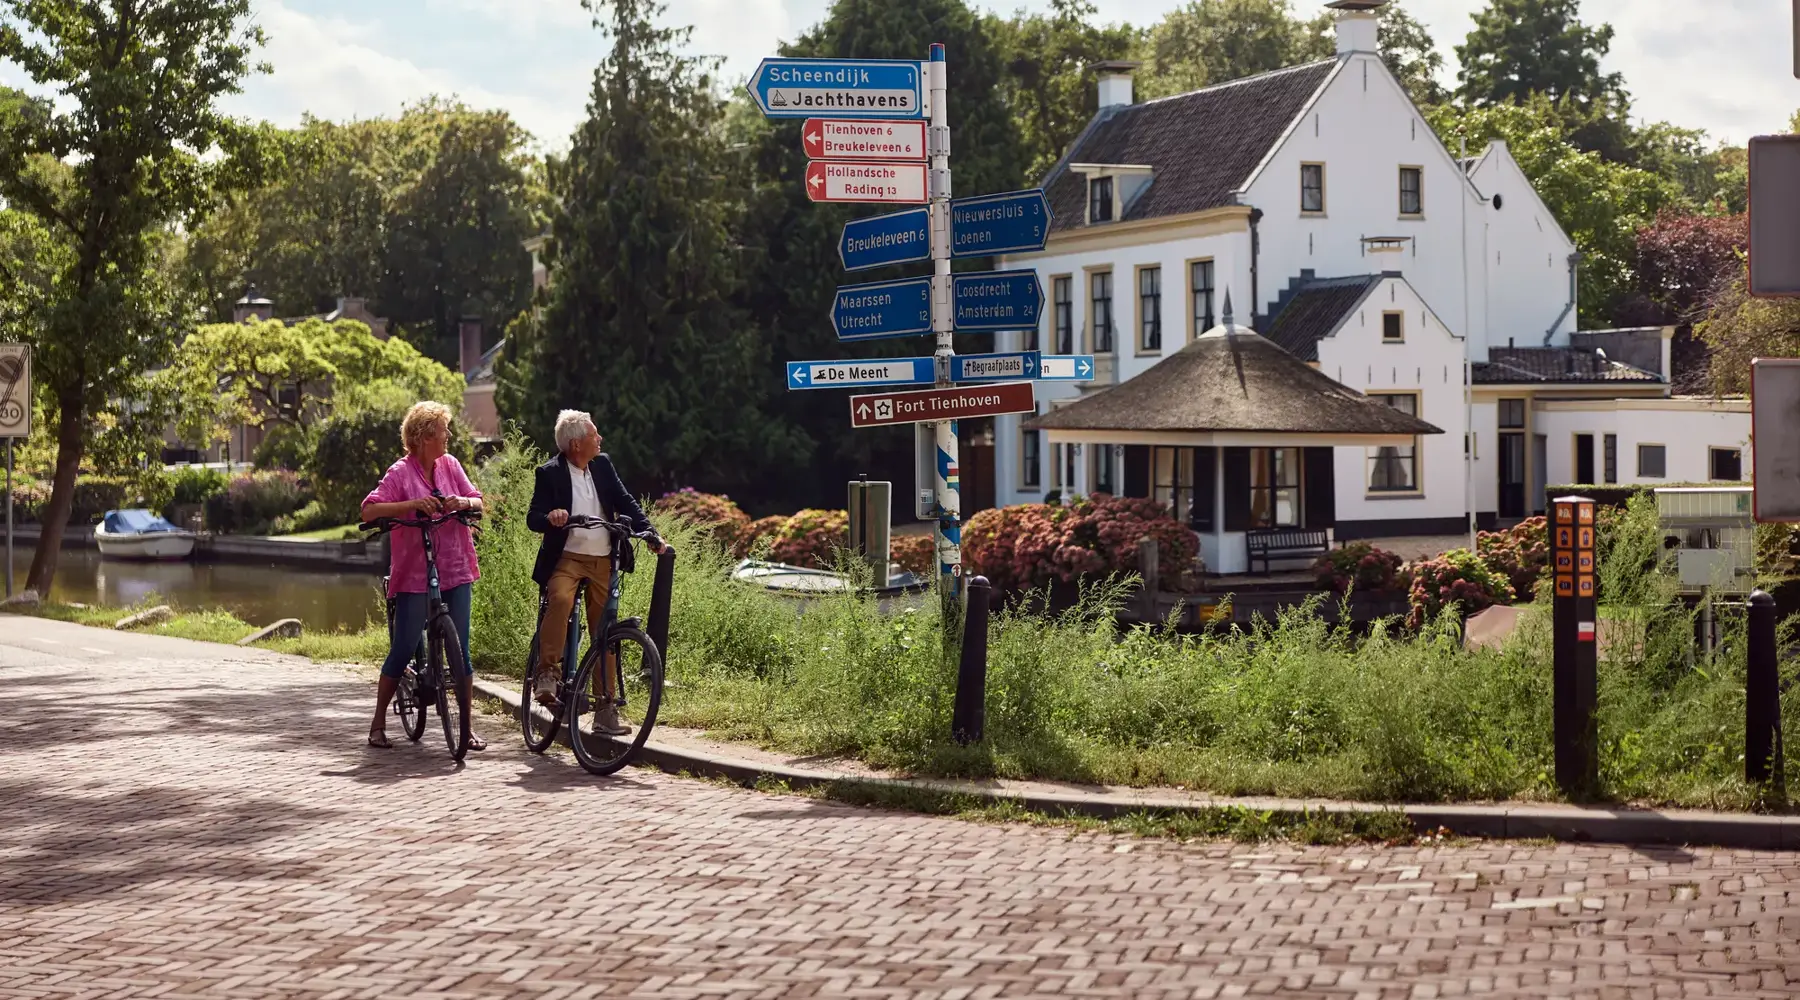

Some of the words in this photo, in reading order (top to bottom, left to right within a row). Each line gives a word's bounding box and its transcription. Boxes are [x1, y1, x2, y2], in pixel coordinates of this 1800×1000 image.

[769, 67, 870, 87] Scheendijk
[907, 73, 912, 83] 1
[792, 92, 908, 107] Jachthavens
[825, 123, 883, 136] Tienhoven
[886, 128, 893, 136] 6
[825, 141, 902, 153] Breukeleveen
[905, 145, 911, 153] 6
[827, 167, 896, 178] Hollandsche
[845, 184, 884, 197] Rading
[887, 187, 897, 195] 13
[954, 203, 1024, 225] Nieuwersluis
[1033, 204, 1039, 215] 3
[847, 230, 917, 253] Breukeleveen
[918, 228, 925, 241] 6
[954, 230, 992, 245] Loenen
[1033, 225, 1040, 237] 5
[956, 281, 1011, 298] Loosdrecht
[1027, 283, 1033, 294] 9
[840, 294, 892, 310] Maarssen
[921, 290, 927, 300] 5
[957, 303, 1014, 319] Amsterdam
[1023, 305, 1033, 316] 24
[841, 313, 882, 329] Utrecht
[919, 310, 928, 321] 12
[828, 368, 845, 380] De
[849, 366, 889, 380] Meent
[972, 359, 1020, 374] Begraafplaats
[896, 399, 925, 413] Fort
[928, 395, 1001, 410] Tienhoven
